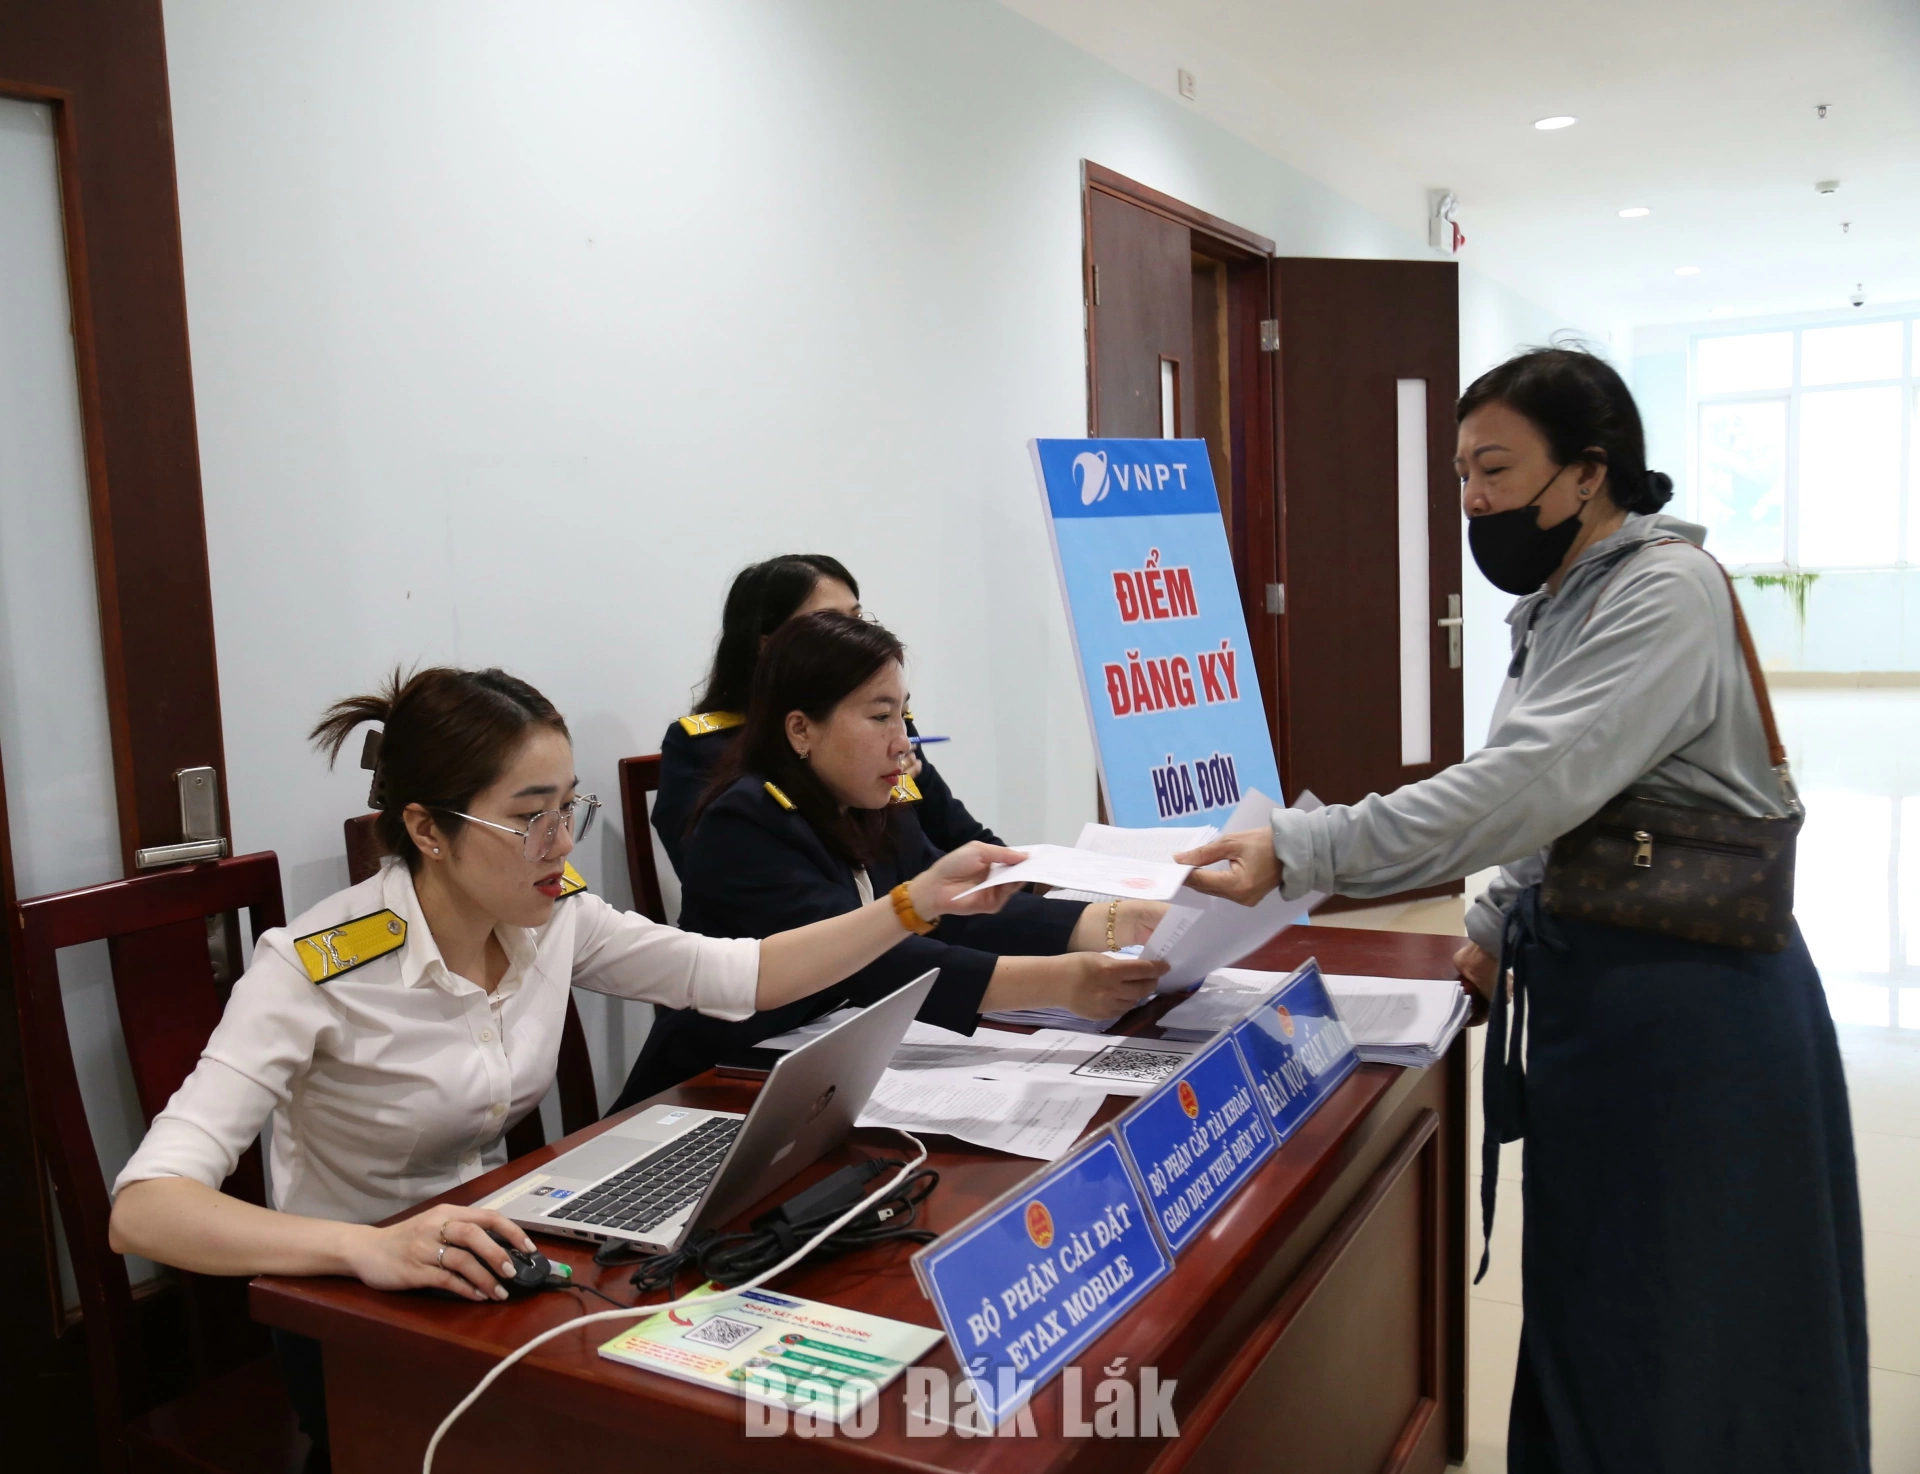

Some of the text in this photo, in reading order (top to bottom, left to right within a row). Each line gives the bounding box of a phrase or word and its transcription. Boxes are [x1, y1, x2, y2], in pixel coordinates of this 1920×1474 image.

[1112, 463, 1188, 492] VNPT
[1112, 549, 1199, 623] ĐIỂM
[1104, 640, 1240, 717] ĐĂNG KÝ
[1152, 753, 1240, 818] HÓA ĐƠN
[1259, 1069, 1290, 1117] BÀN
[1148, 1085, 1253, 1197] BỘ PHẬN CẤP TÀI KHOẢN
[1162, 1112, 1266, 1234] GIAO DỊCH THUẾ ĐIỆN TỬ
[966, 1202, 1133, 1347] BỘ PHẬN CÀI ĐẶT
[1005, 1254, 1135, 1374] ETAX MOBILE
